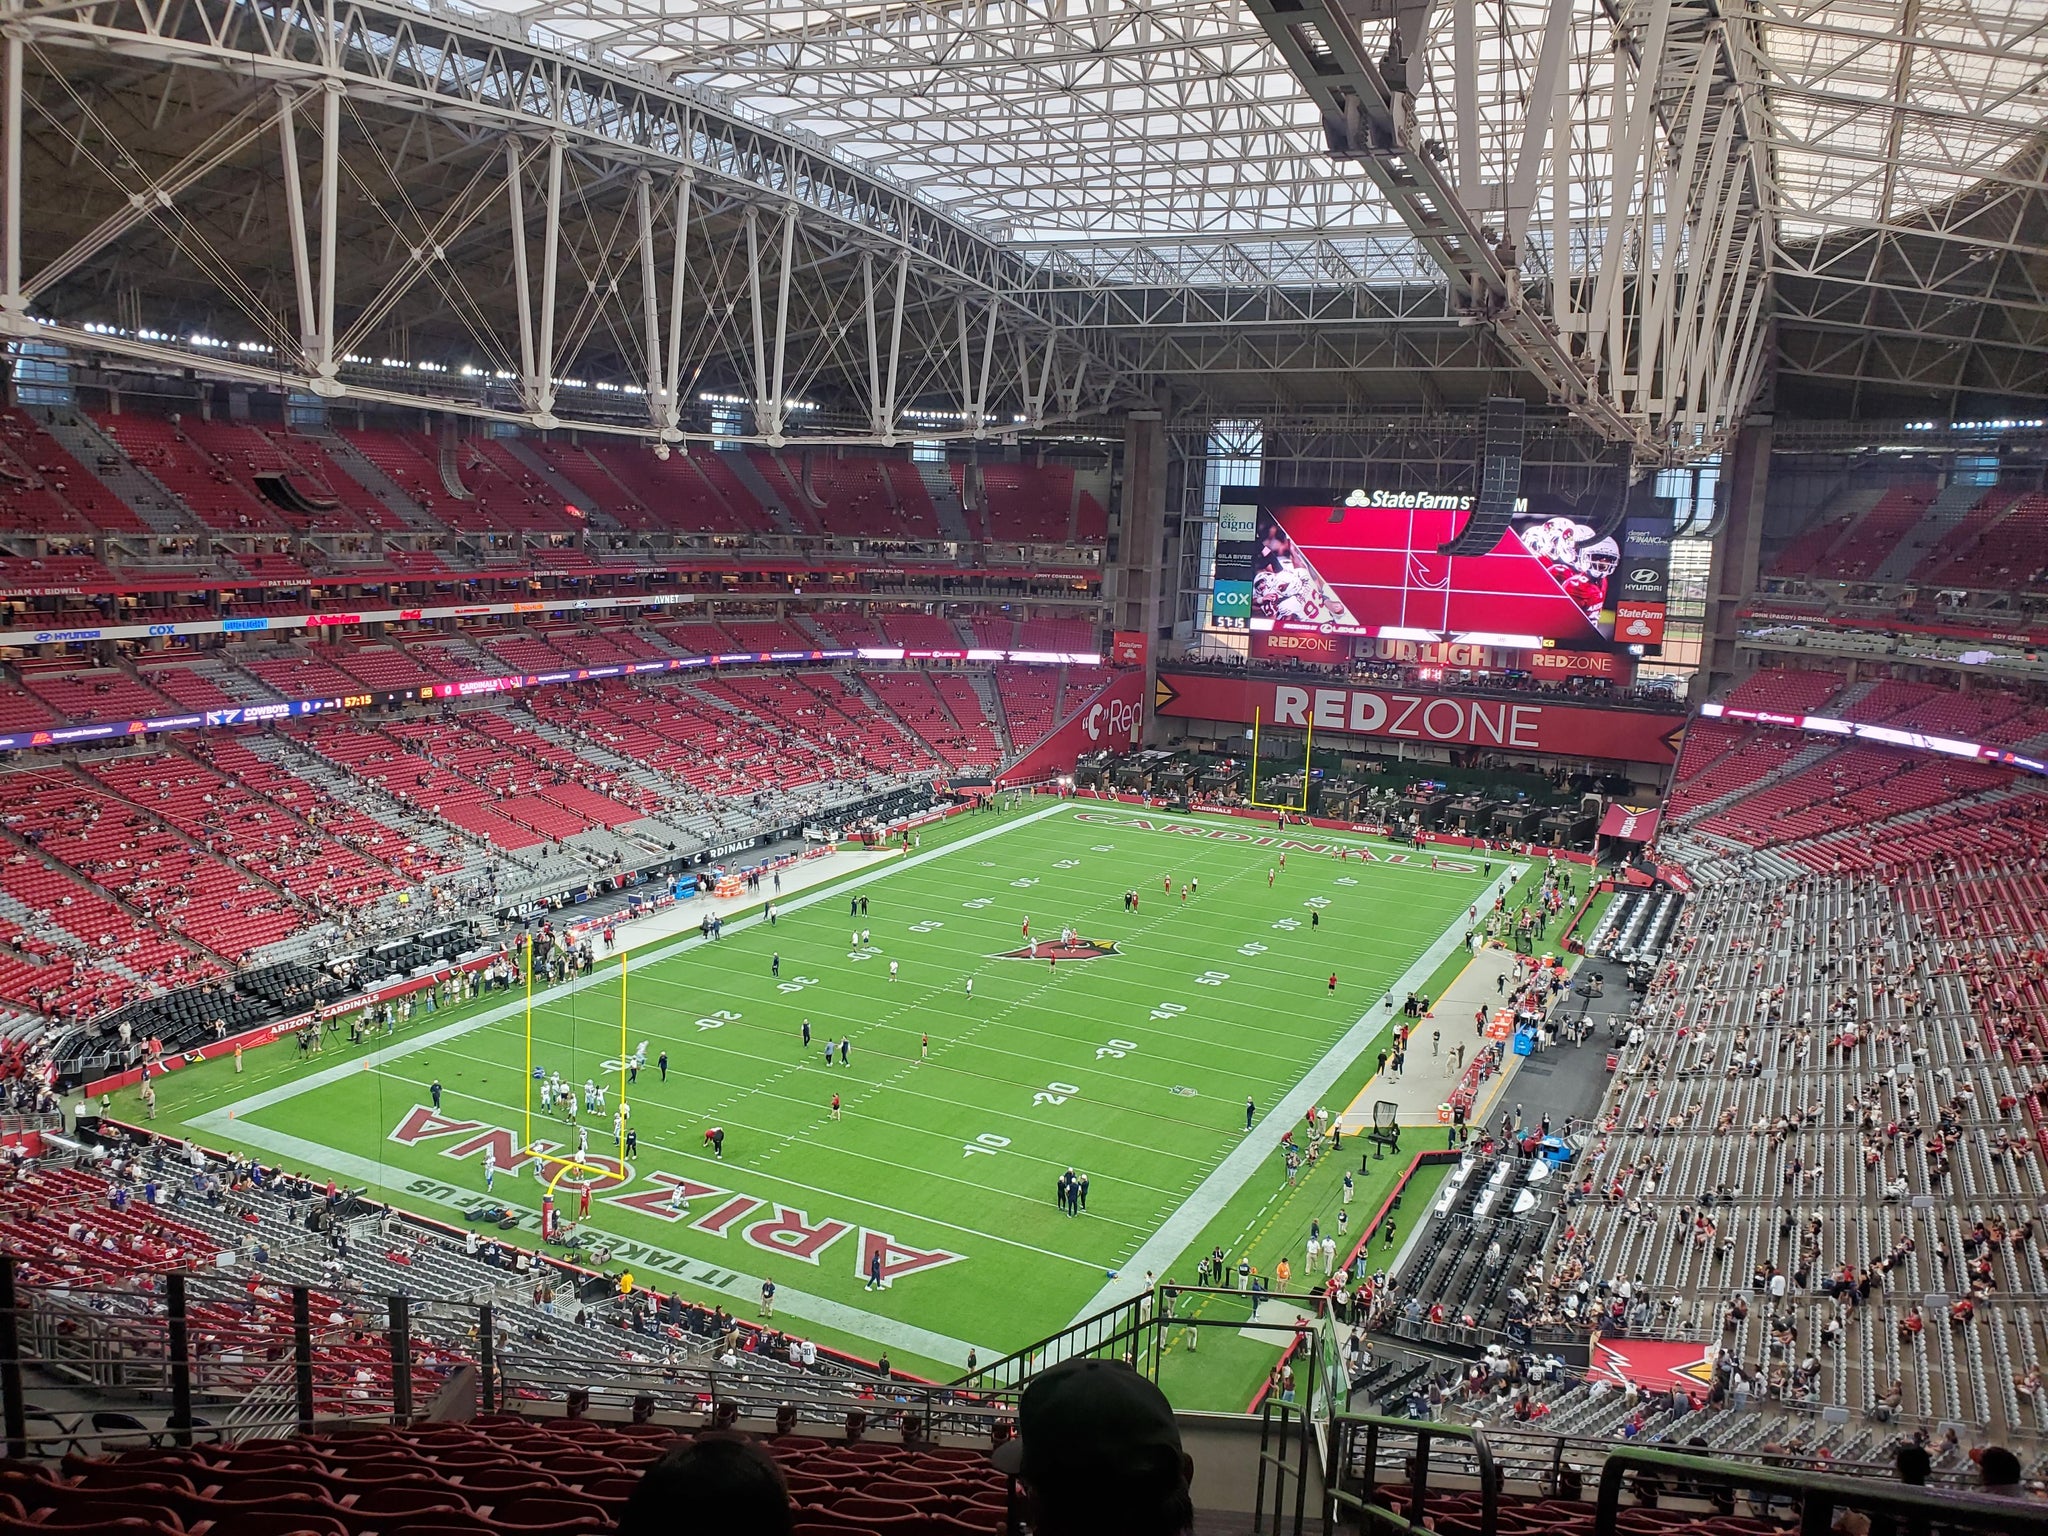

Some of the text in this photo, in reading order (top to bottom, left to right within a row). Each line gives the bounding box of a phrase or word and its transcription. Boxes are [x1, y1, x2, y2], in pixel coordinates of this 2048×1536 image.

[1221, 519, 1254, 532] cigna
[282, 578, 312, 586] TILLMAN
[1625, 584, 1662, 592] HYUNDAI
[0, 588, 32, 596] ILLIAM
[44, 587, 82, 595] BIDWILL
[1216, 591, 1250, 606] COX
[149, 625, 174, 635] COX
[1267, 635, 1337, 652] REDZONE
[1532, 653, 1612, 671] REDZONE
[459, 680, 498, 691] CARDINALS
[344, 694, 373, 707] 57:15
[244, 703, 290, 717] COWBOYS
[1274, 685, 1542, 748] REDZONE
[1192, 805, 1232, 815] CARDINALS
[1352, 825, 1388, 835] ARIZONA
[694, 839, 756, 864] CRDINALS
[908, 920, 945, 934] 50
[777, 976, 820, 994] 30
[1194, 970, 1231, 986] 50
[270, 993, 380, 1034] ARIZON CARDINALS
[1149, 1002, 1188, 1021] 40
[695, 1009, 743, 1032] 20
[1095, 1038, 1138, 1060] 30
[1032, 1081, 1080, 1107] 20
[962, 1132, 1012, 1158] 10
[387, 1103, 970, 1288] ARIZONA
[406, 1180, 456, 1200] US
